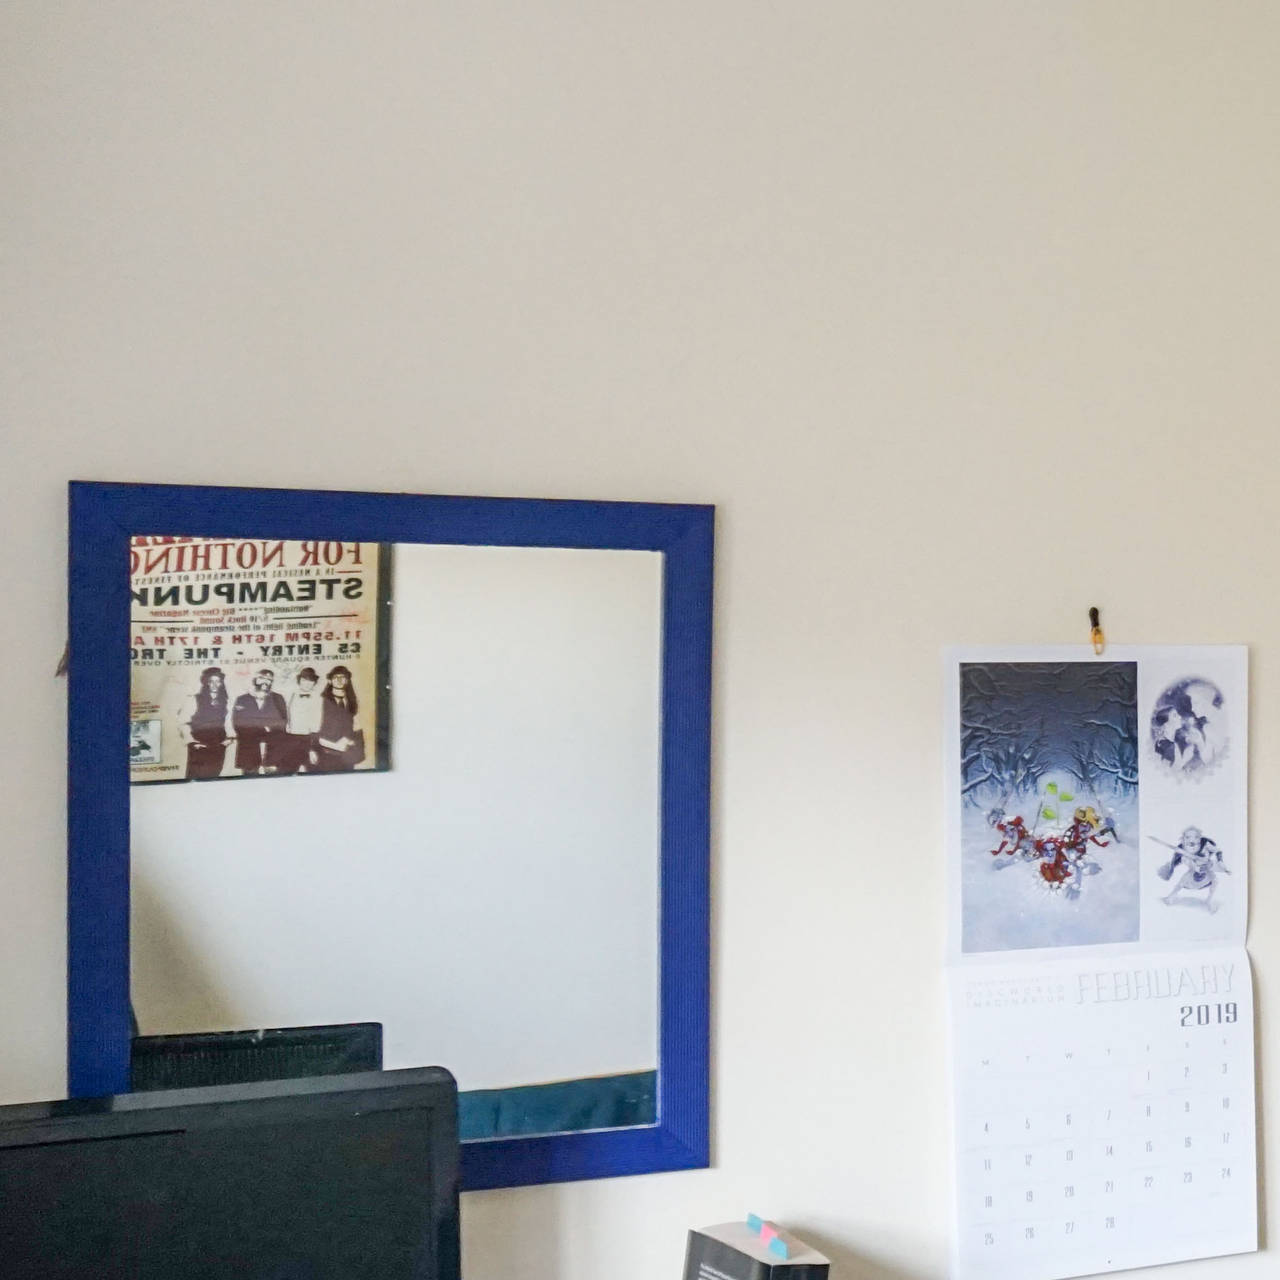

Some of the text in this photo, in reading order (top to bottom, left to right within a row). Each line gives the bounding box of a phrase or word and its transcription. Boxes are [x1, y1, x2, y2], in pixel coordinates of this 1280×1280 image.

[1076, 963, 1234, 1005] FEBRUARY
[1179, 1002, 1238, 1028] 2019
[1222, 1096, 1230, 1110] 10
[984, 1131, 1230, 1171] 11 12 13 14 15 16 17
[984, 1167, 1231, 1209] 18 19 20 21 22 23 24
[984, 1216, 1116, 1246] 25 26 27 28
